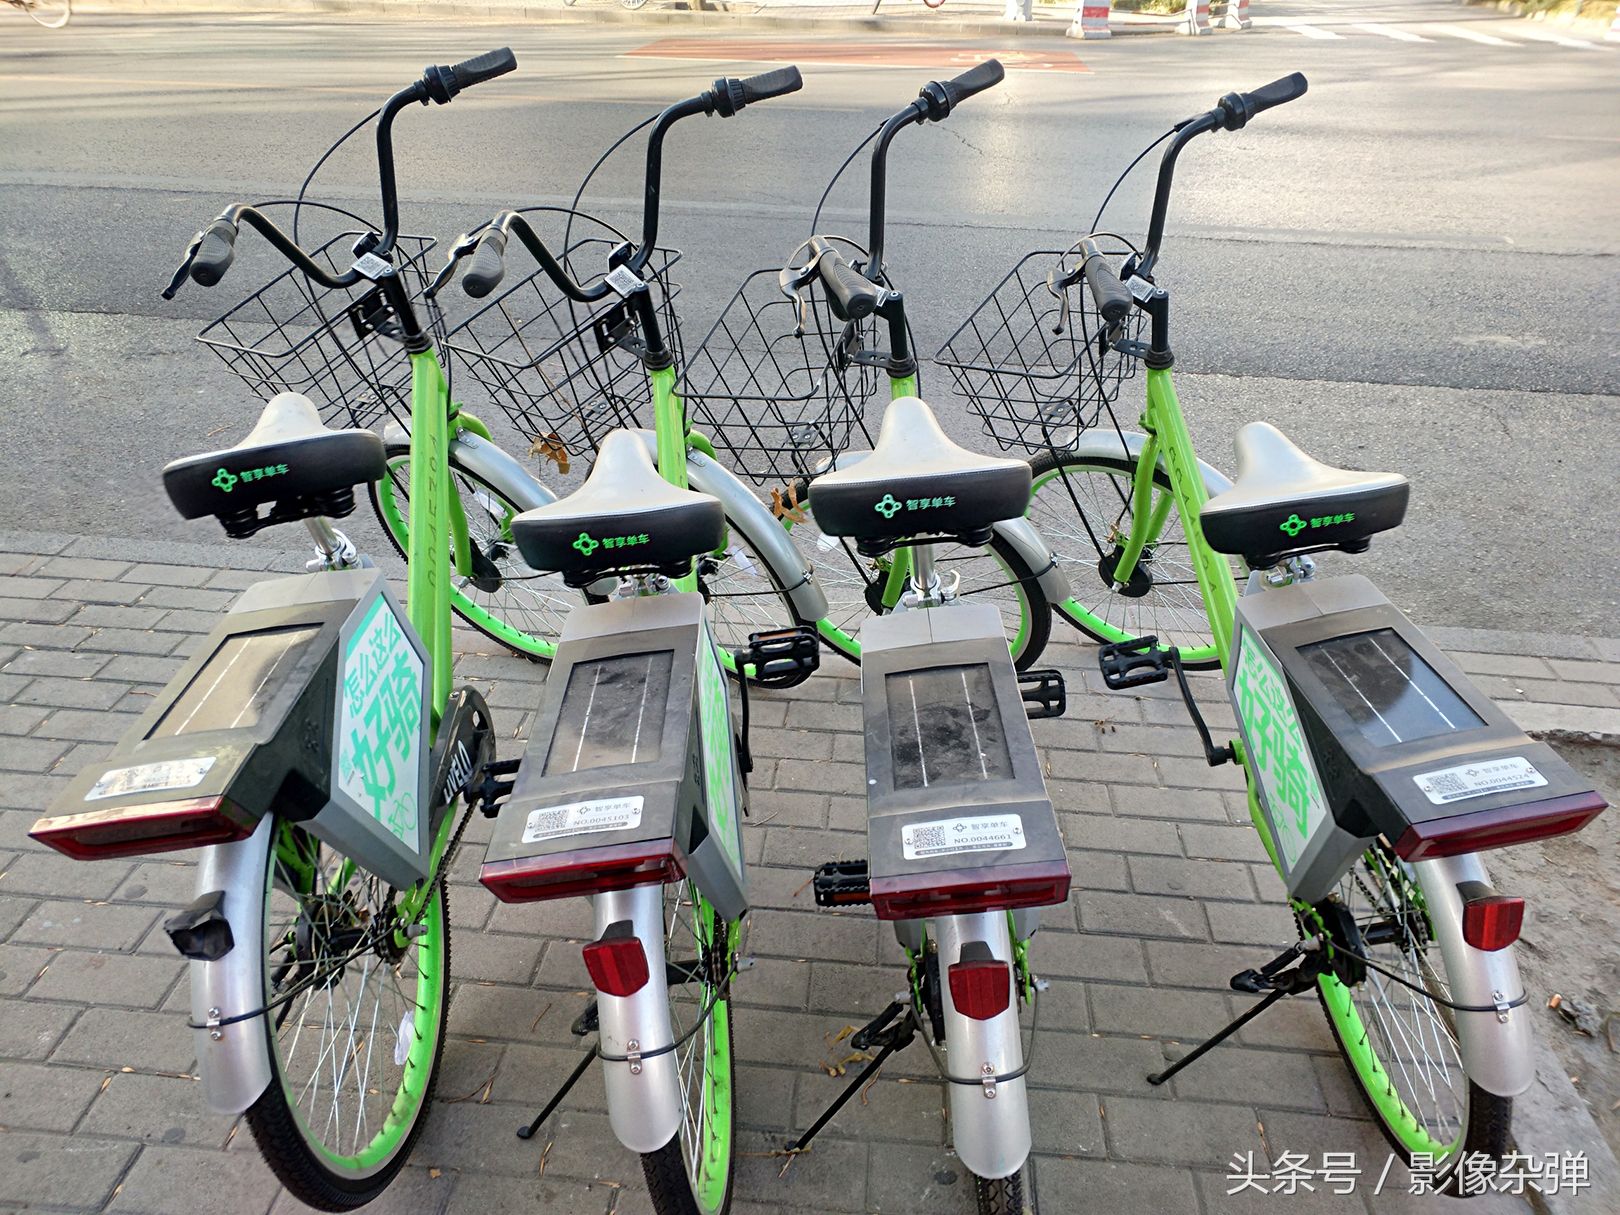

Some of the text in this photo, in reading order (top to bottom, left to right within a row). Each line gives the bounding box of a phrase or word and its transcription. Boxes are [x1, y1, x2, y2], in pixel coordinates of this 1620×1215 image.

[240, 463, 290, 483] 智享单车
[905, 495, 957, 511] 智享单车
[1310, 512, 1356, 529] 智享单车
[602, 533, 650, 549] 智享单车
[343, 612, 402, 719] 怎么这么
[1243, 640, 1304, 752] 怎么这么
[350, 651, 422, 822] 好骑
[1238, 667, 1310, 840] 好骑
[954, 834, 1012, 844] NO.0044661
